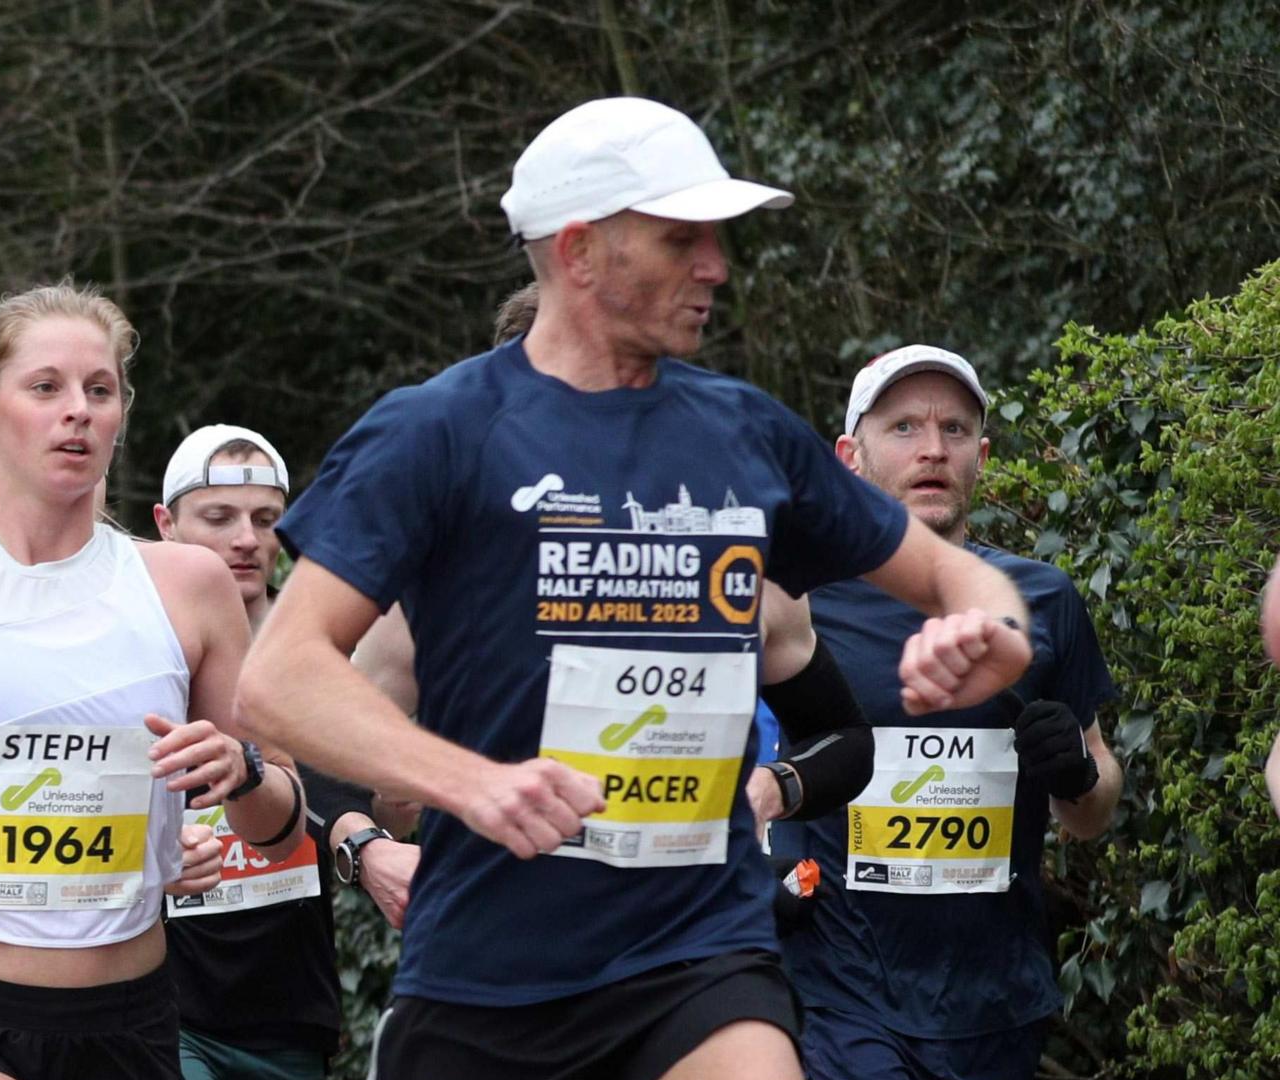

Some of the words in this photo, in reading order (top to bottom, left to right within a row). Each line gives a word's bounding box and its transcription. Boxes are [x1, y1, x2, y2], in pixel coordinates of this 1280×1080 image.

[539, 542, 701, 577] READING
[537, 578, 593, 597] HALF
[597, 579, 700, 598] MARATHON
[725, 572, 757, 597] 13.1
[536, 602, 583, 622] 2ND
[587, 603, 647, 623] APRIL
[651, 604, 700, 623] 2023
[616, 666, 706, 697] 6084
[1, 733, 111, 761] STEPH
[645, 730, 706, 743] Unleashed
[905, 735, 974, 760] TOM
[629, 743, 703, 755] Performance
[42, 790, 104, 801] Unleashed
[604, 774, 700, 803] PACER
[916, 795, 980, 805] Performance
[929, 785, 980, 795] Unleashed
[28, 802, 103, 813] Performance
[854, 810, 863, 851] YELLOW
[886, 815, 990, 850] 2790
[2, 825, 114, 864] 1964
[0, 888, 22, 896] HALF
